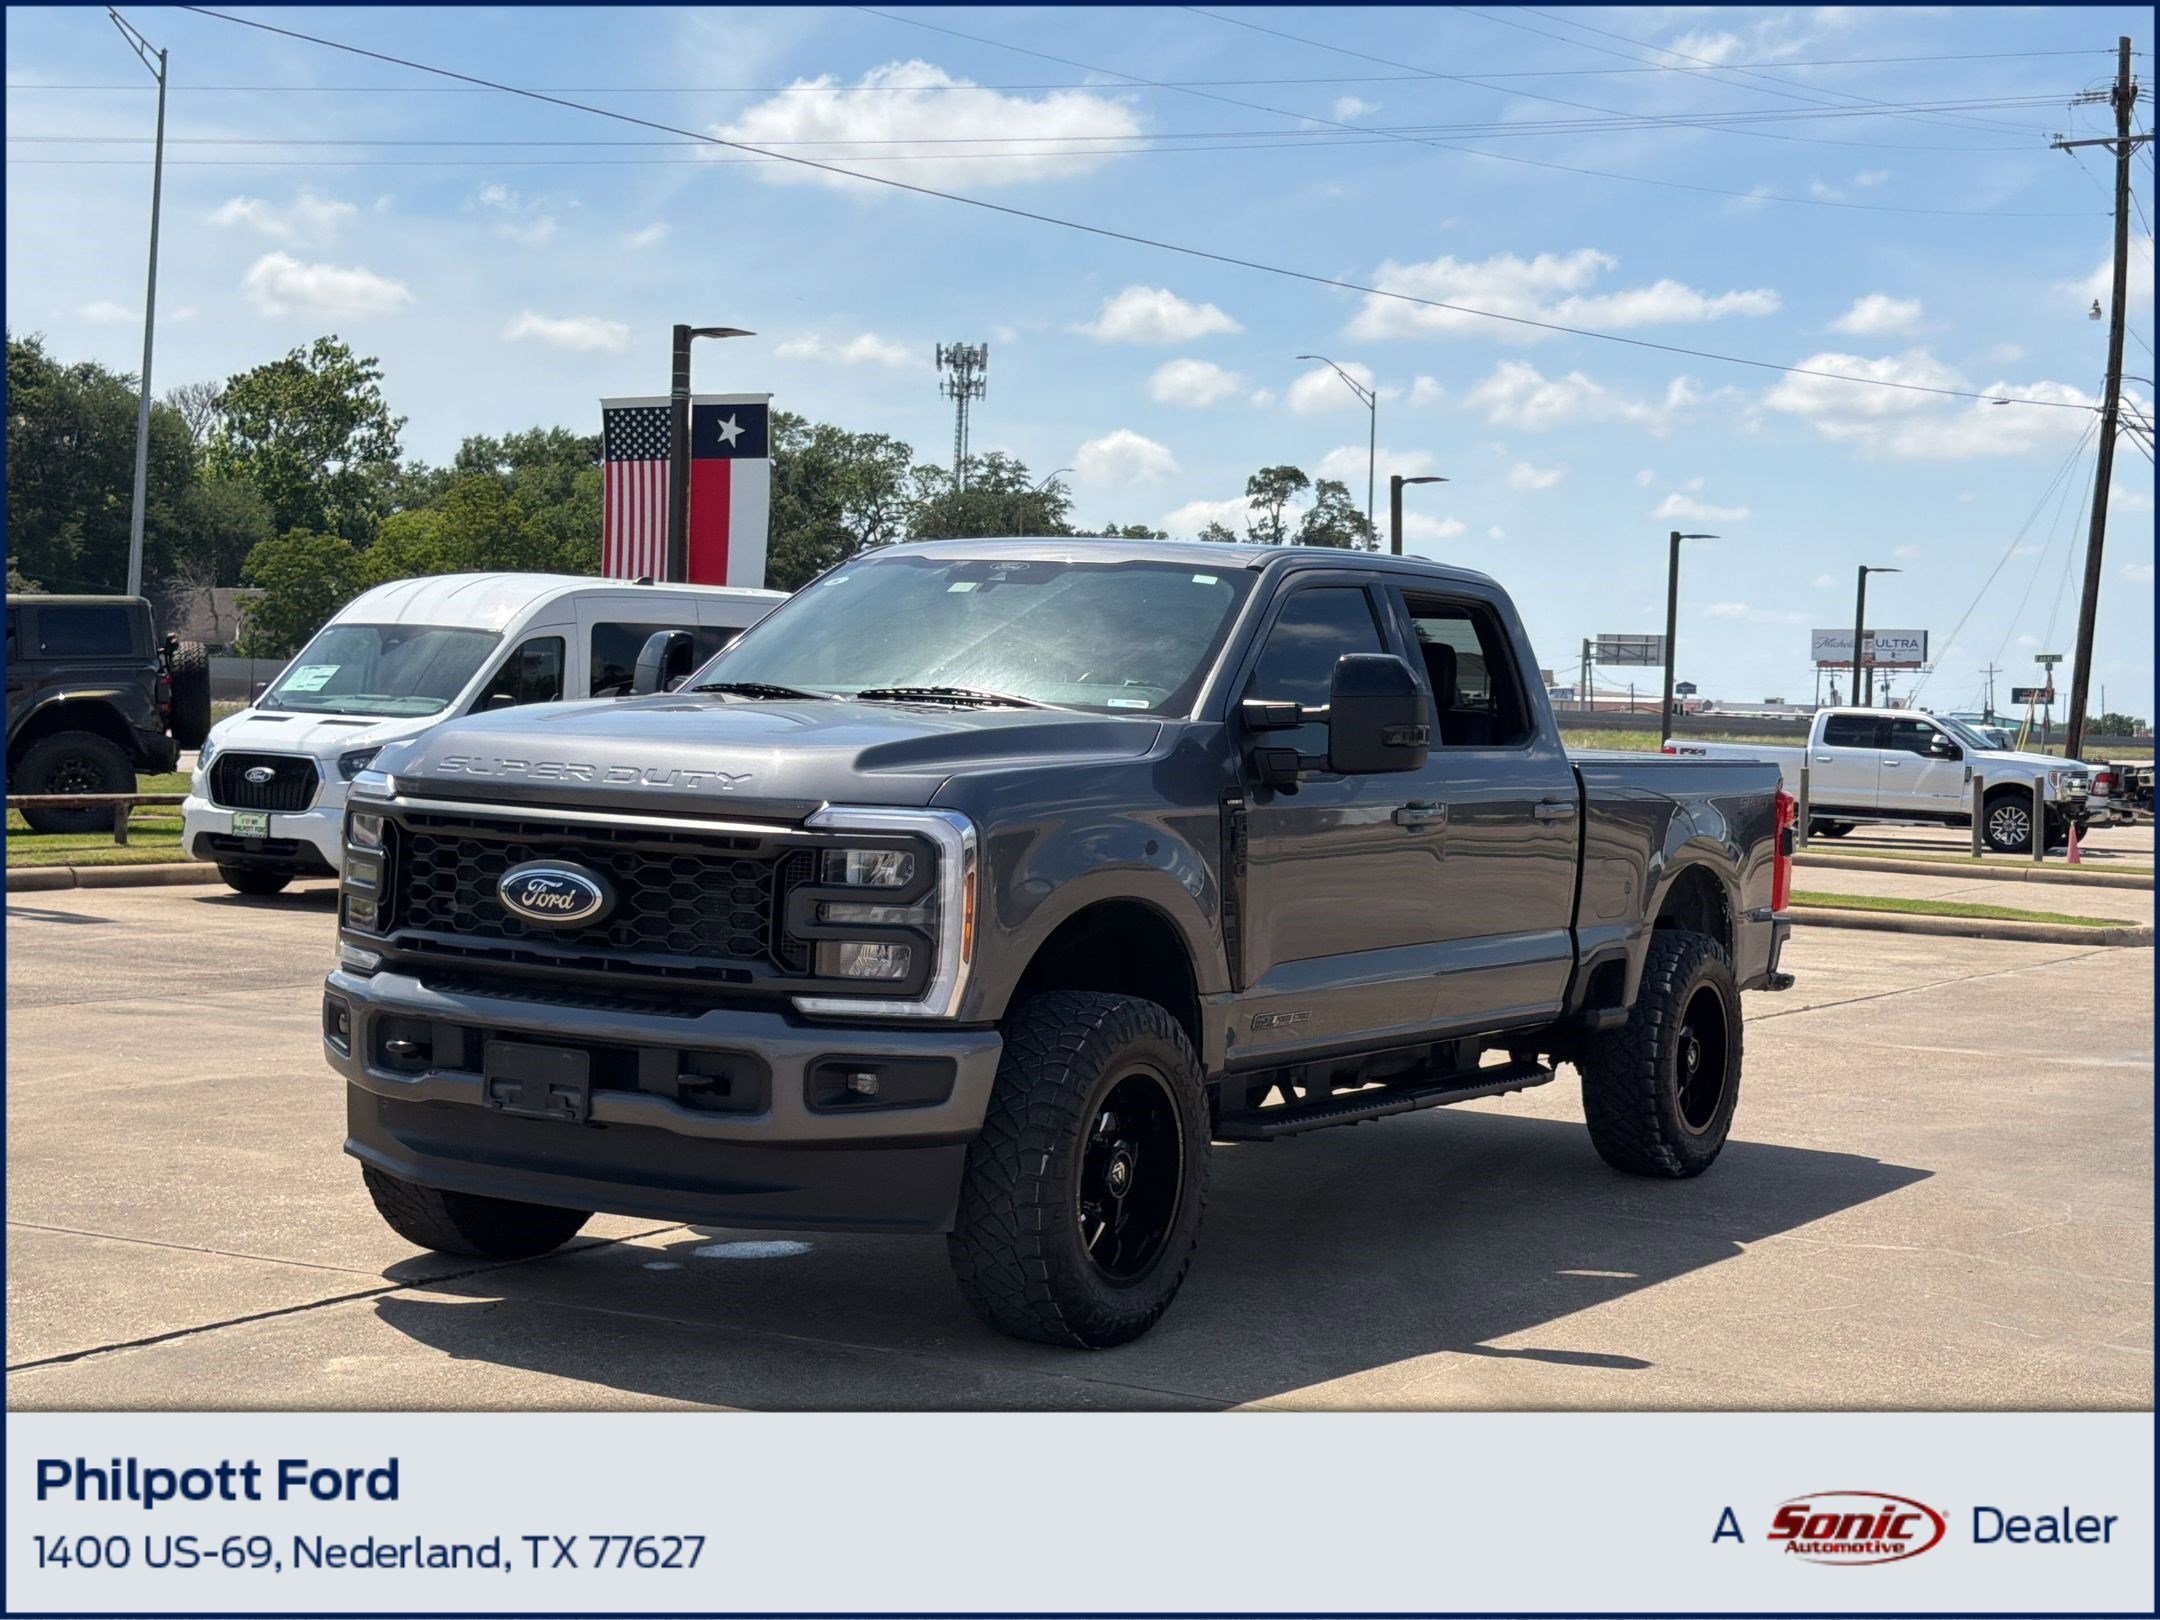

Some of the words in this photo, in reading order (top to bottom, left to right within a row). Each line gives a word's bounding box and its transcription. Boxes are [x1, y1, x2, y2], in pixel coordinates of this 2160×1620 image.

[1875, 639, 1919, 649] ULTRA
[437, 755, 597, 782] SUPER
[603, 766, 753, 790] DUTY
[522, 878, 577, 909] Ford
